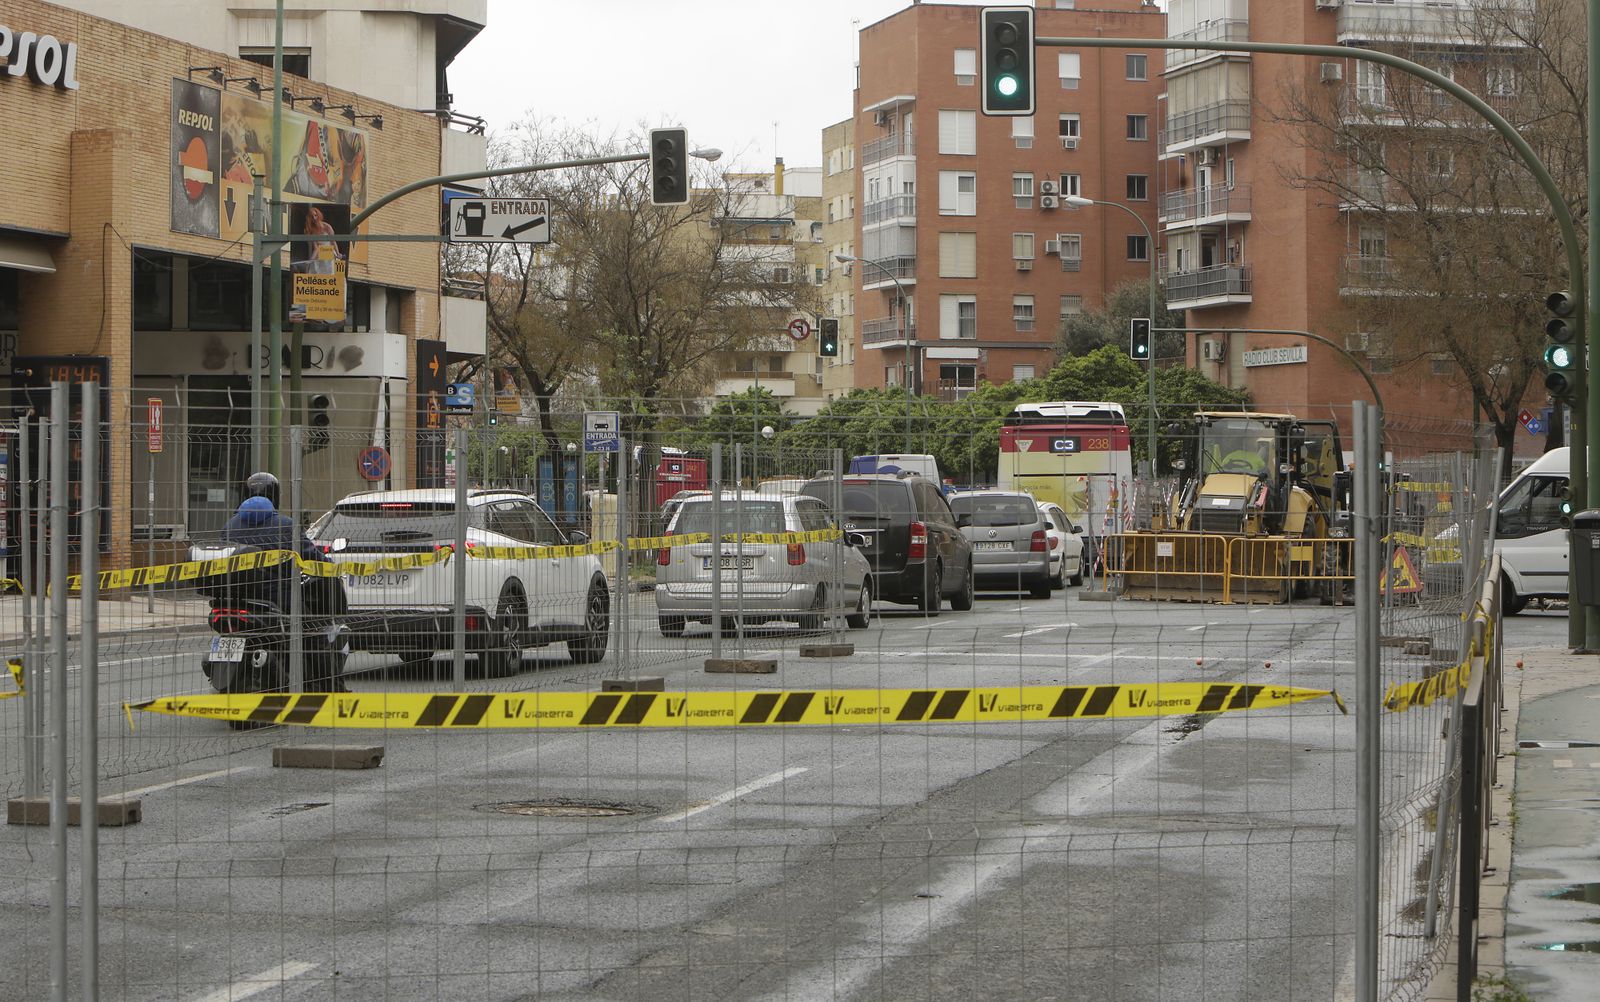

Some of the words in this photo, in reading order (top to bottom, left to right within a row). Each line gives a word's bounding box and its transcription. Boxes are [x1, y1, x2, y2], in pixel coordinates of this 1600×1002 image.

[178, 108, 214, 132] REPSOL
[491, 201, 547, 215] ENTRADA
[296, 276, 327, 285] Pelléas
[328, 278, 337, 286] et
[296, 286, 340, 296] Mélisande
[1244, 352, 1262, 365] RADIO
[1263, 350, 1278, 364] CLUB
[1279, 348, 1303, 362] SEVILLA
[447, 387, 455, 395] B
[458, 386, 472, 405] S
[586, 432, 617, 440] ENTRADA
[1054, 440, 1074, 450] C3
[1088, 438, 1110, 450] 238
[358, 574, 384, 586] 1082
[387, 574, 409, 586] LVP
